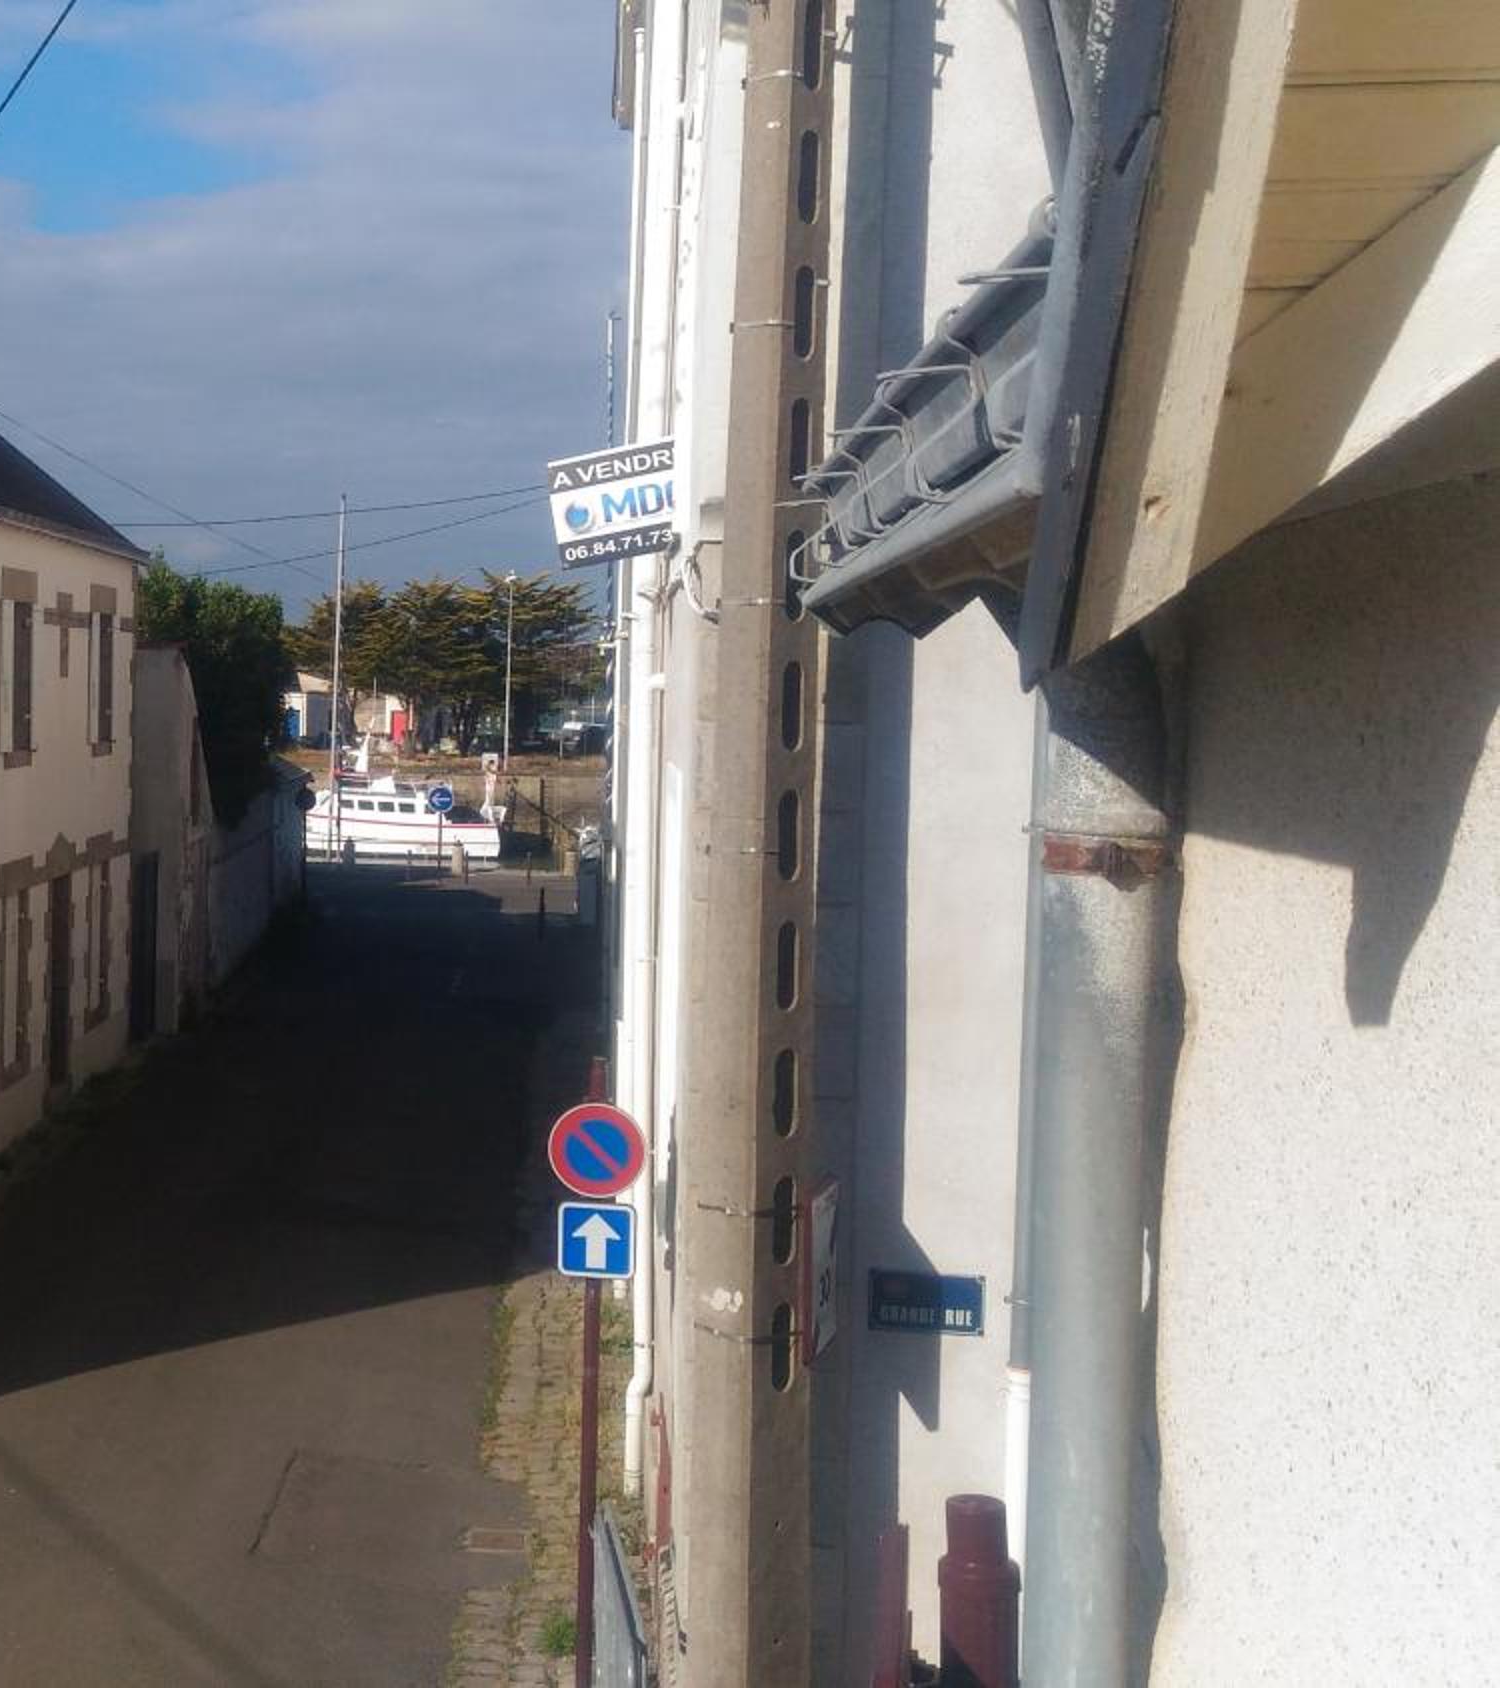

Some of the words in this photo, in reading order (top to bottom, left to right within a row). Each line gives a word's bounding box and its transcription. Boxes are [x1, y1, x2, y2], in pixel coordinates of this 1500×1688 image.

[553, 471, 573, 489] A
[576, 449, 674, 482] VENDR
[565, 529, 674, 561] 06.84.71.73
[945, 1308, 973, 1326] RUE
